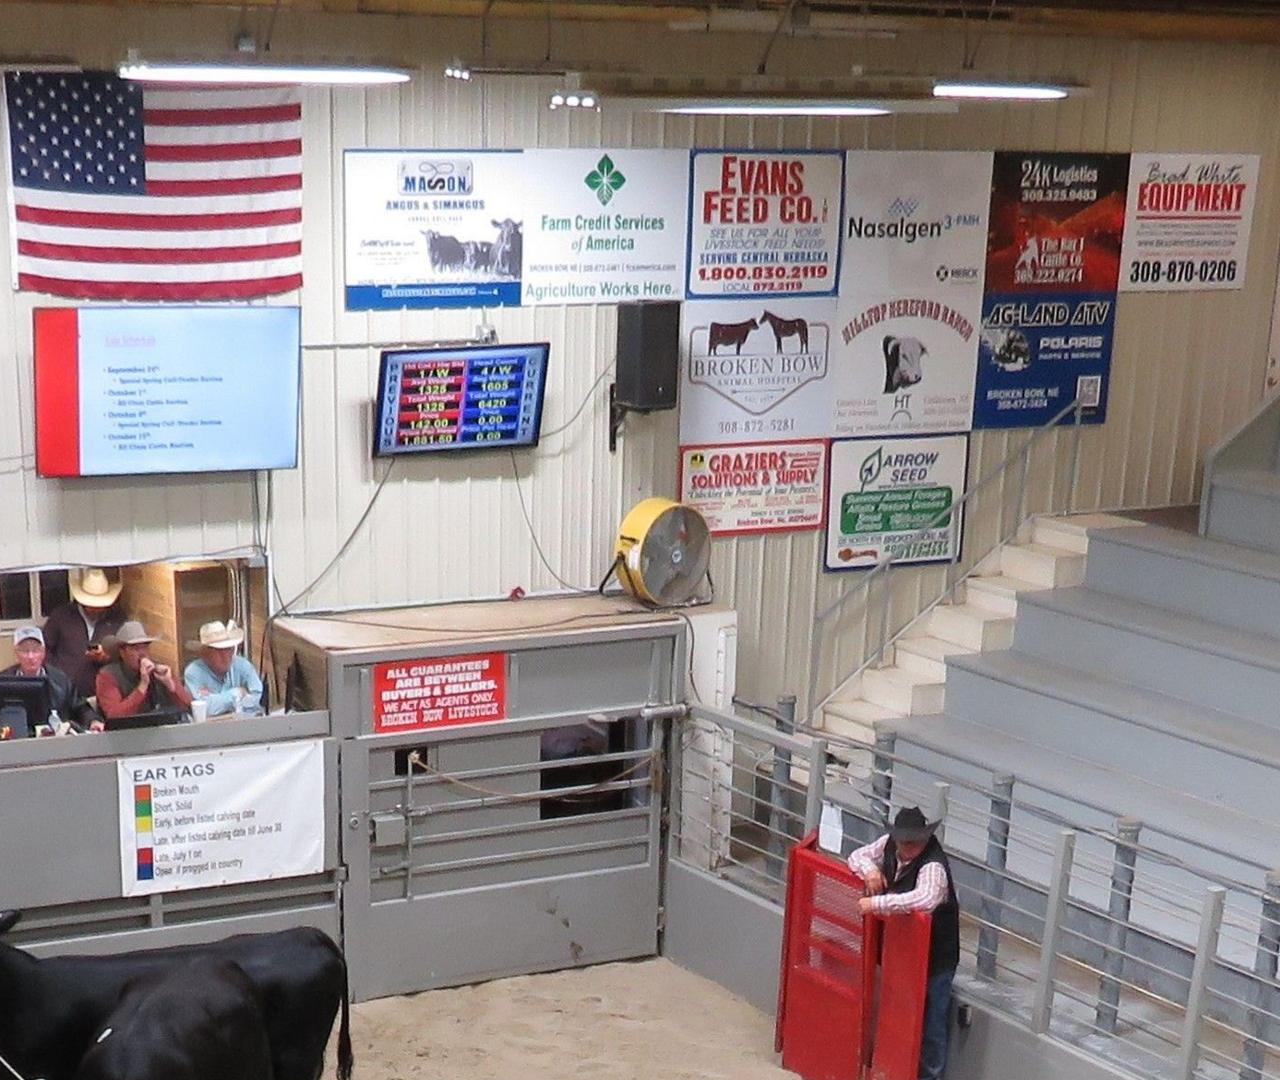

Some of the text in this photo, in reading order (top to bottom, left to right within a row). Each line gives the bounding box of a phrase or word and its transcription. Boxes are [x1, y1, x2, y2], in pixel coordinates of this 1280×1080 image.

[721, 155, 805, 196] EVANS
[1021, 160, 1098, 188] 24K Logistics
[1147, 161, 1243, 182] Brad White
[403, 174, 470, 194] MASON
[386, 199, 420, 211] ANGUS
[1137, 182, 1246, 212] EQUIPMENT
[703, 191, 819, 224] FEED CO.
[541, 213, 665, 231] Farm Credit Services
[848, 216, 942, 243] Nasalgen
[571, 235, 635, 253] of America
[699, 251, 829, 265] SERVING CENTRAL NEBRASKA
[698, 265, 828, 281] 1.800.830.2119
[525, 281, 674, 301] Agriculture Works Here.
[722, 282, 751, 292] LOCAL
[841, 299, 975, 346] HILLTOP HEREFORD RANCH
[1071, 300, 1111, 326] ATV
[1039, 335, 1104, 351] POLARIS
[692, 354, 824, 377] BROKEN BOW
[718, 375, 802, 387] ANIMAL HOSPITAL
[986, 388, 1022, 400] BROKEN
[708, 450, 787, 473] GRAZIERS
[882, 451, 940, 468] ARROW
[691, 468, 818, 490] SOLUTIONS & SUPPLY
[890, 467, 928, 483] SEED
[386, 659, 490, 680] ALL GUARANTEES
[381, 679, 498, 702] BUYERS & SELLERS.
[395, 671, 482, 690] ARE BETWEEN
[383, 691, 495, 713] WE ACT AS AGENTS ONLY.
[380, 702, 498, 728] BROKEN BOW LIVESTOCK
[133, 762, 216, 783] EAR TAGS
[153, 784, 200, 798] Broken Mouth
[175, 800, 193, 811] Solid
[174, 815, 195, 826] before
[196, 813, 216, 824] listed
[216, 811, 241, 824] calving
[242, 809, 256, 819] date
[188, 831, 207, 842] listed
[208, 829, 232, 841] calving
[232, 828, 246, 838] date
[257, 824, 273, 835] June
[218, 858, 244, 870] country
